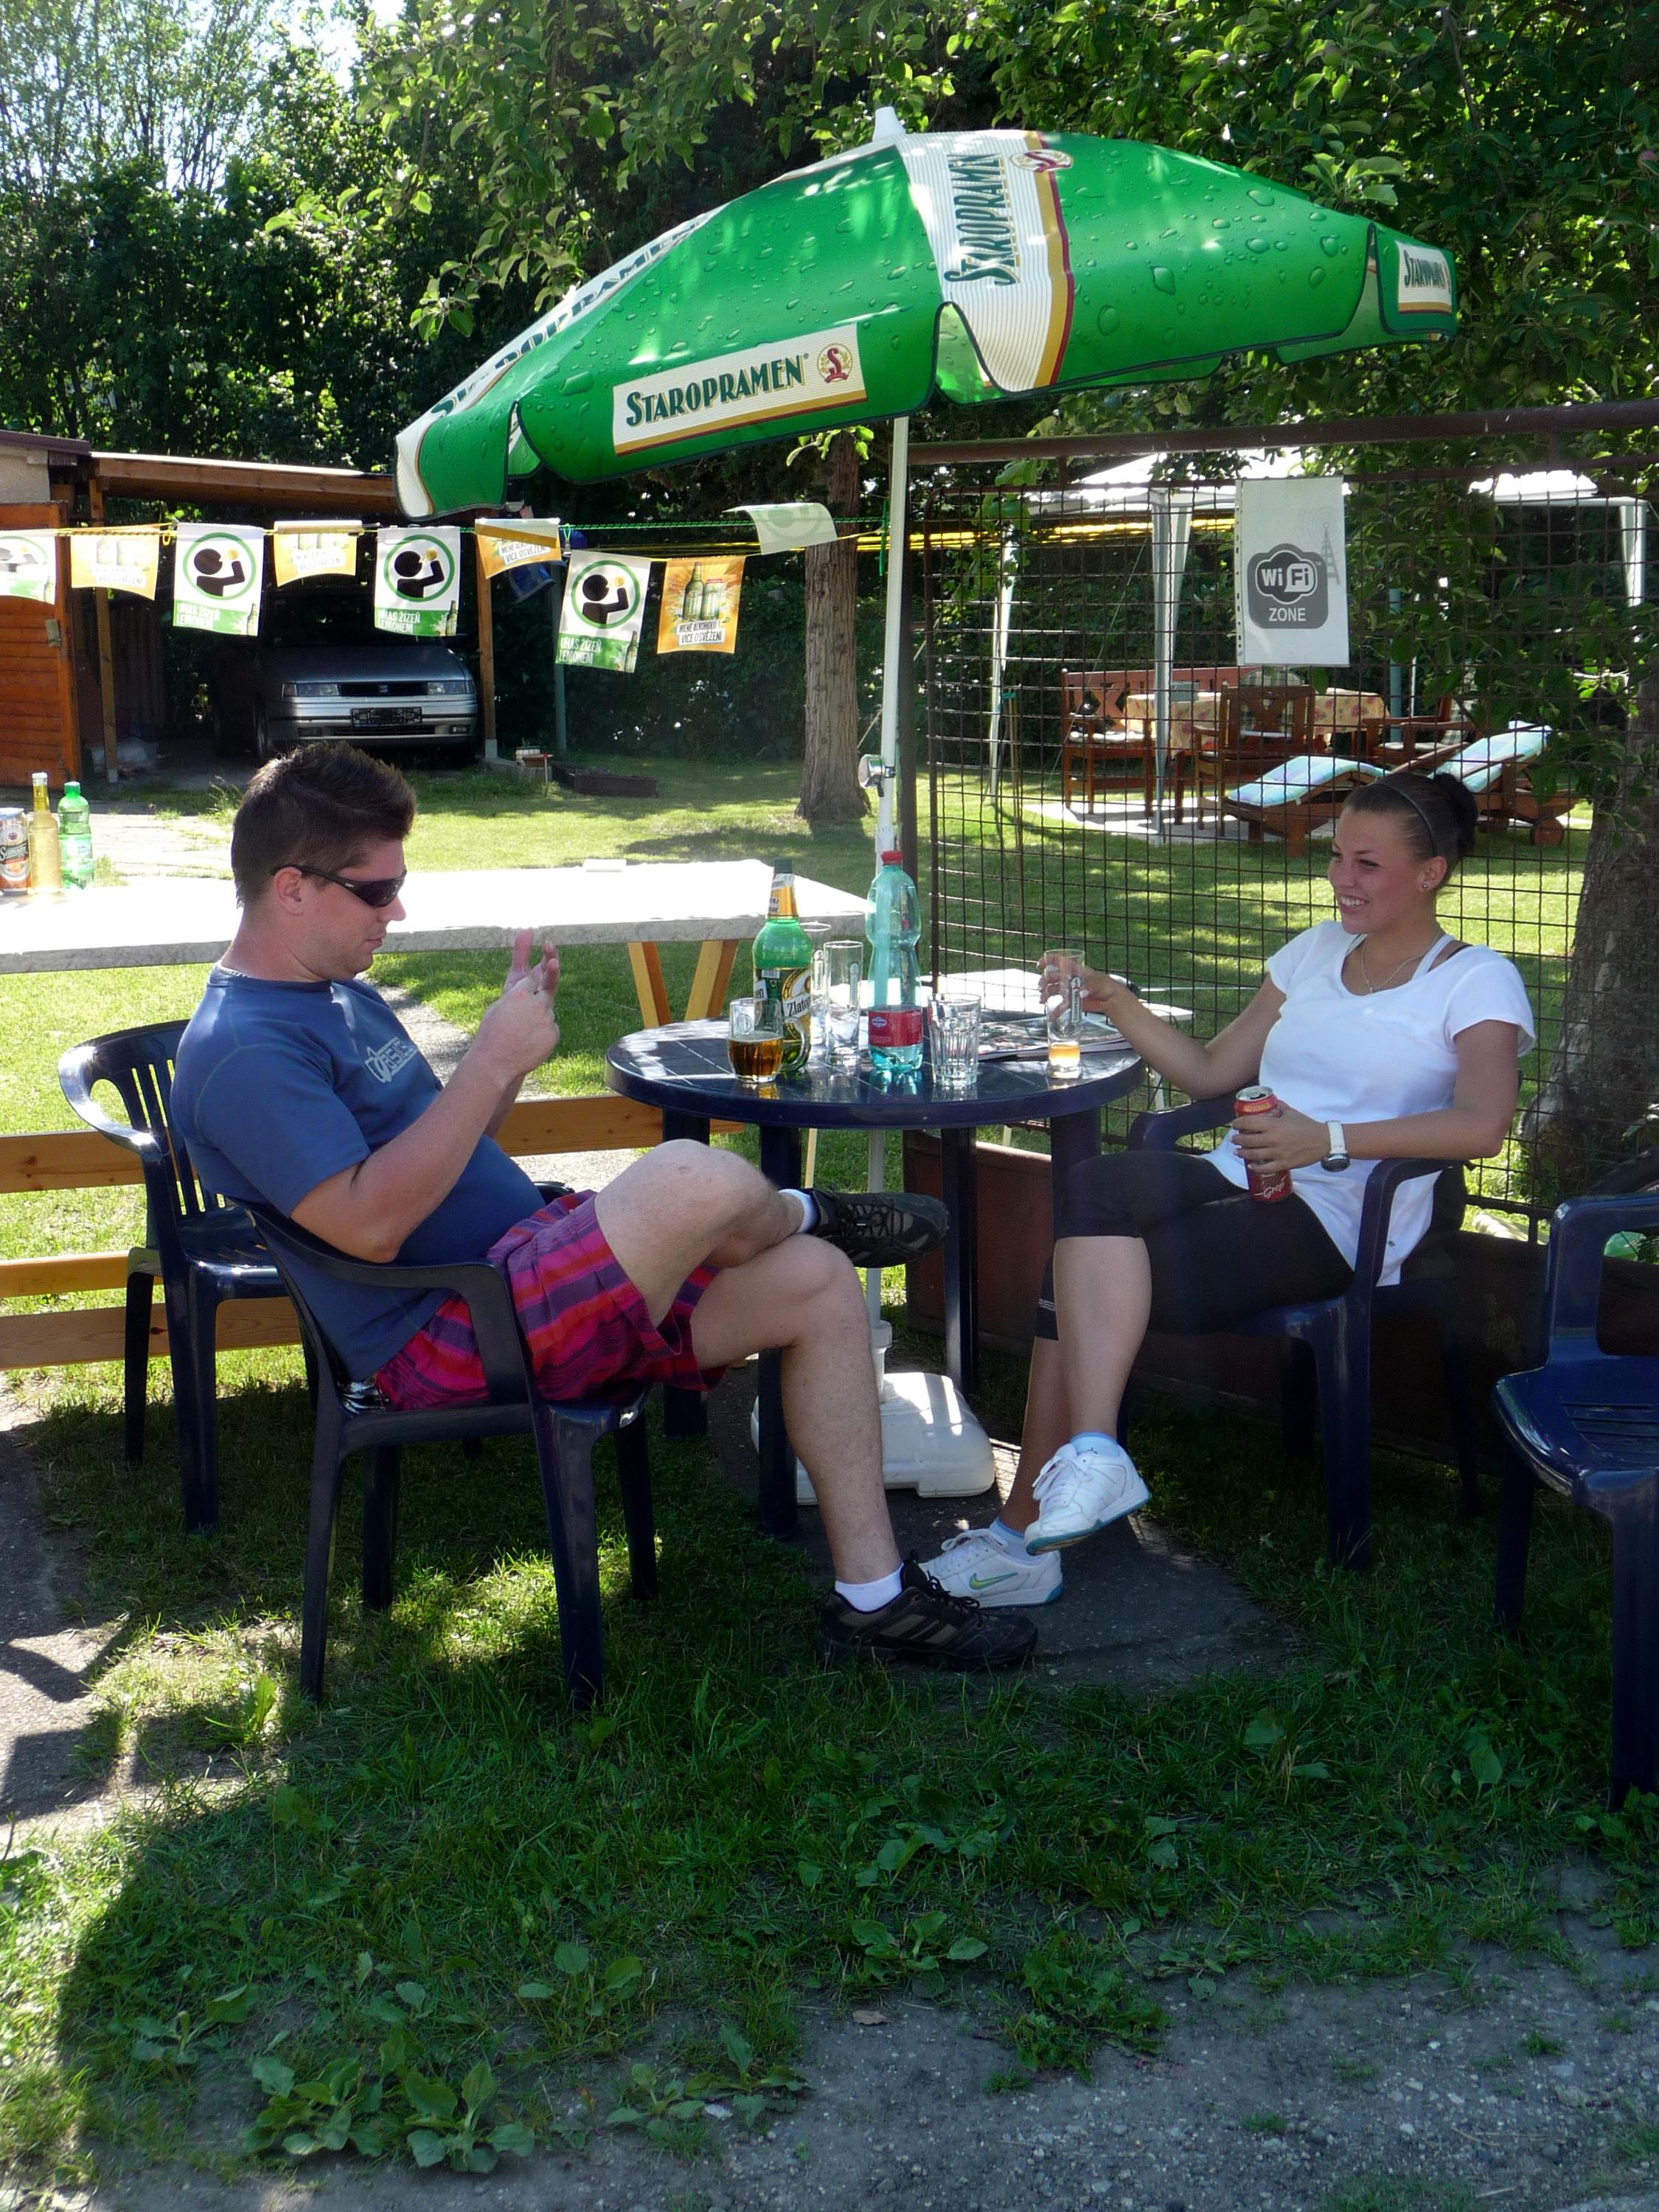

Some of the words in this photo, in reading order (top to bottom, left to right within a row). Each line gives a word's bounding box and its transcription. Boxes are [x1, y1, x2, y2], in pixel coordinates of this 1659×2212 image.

[944, 153, 1020, 286] STAROPRAMEN
[627, 354, 805, 428] STAROPRAMEN
[1268, 607, 1307, 622] ZONE
